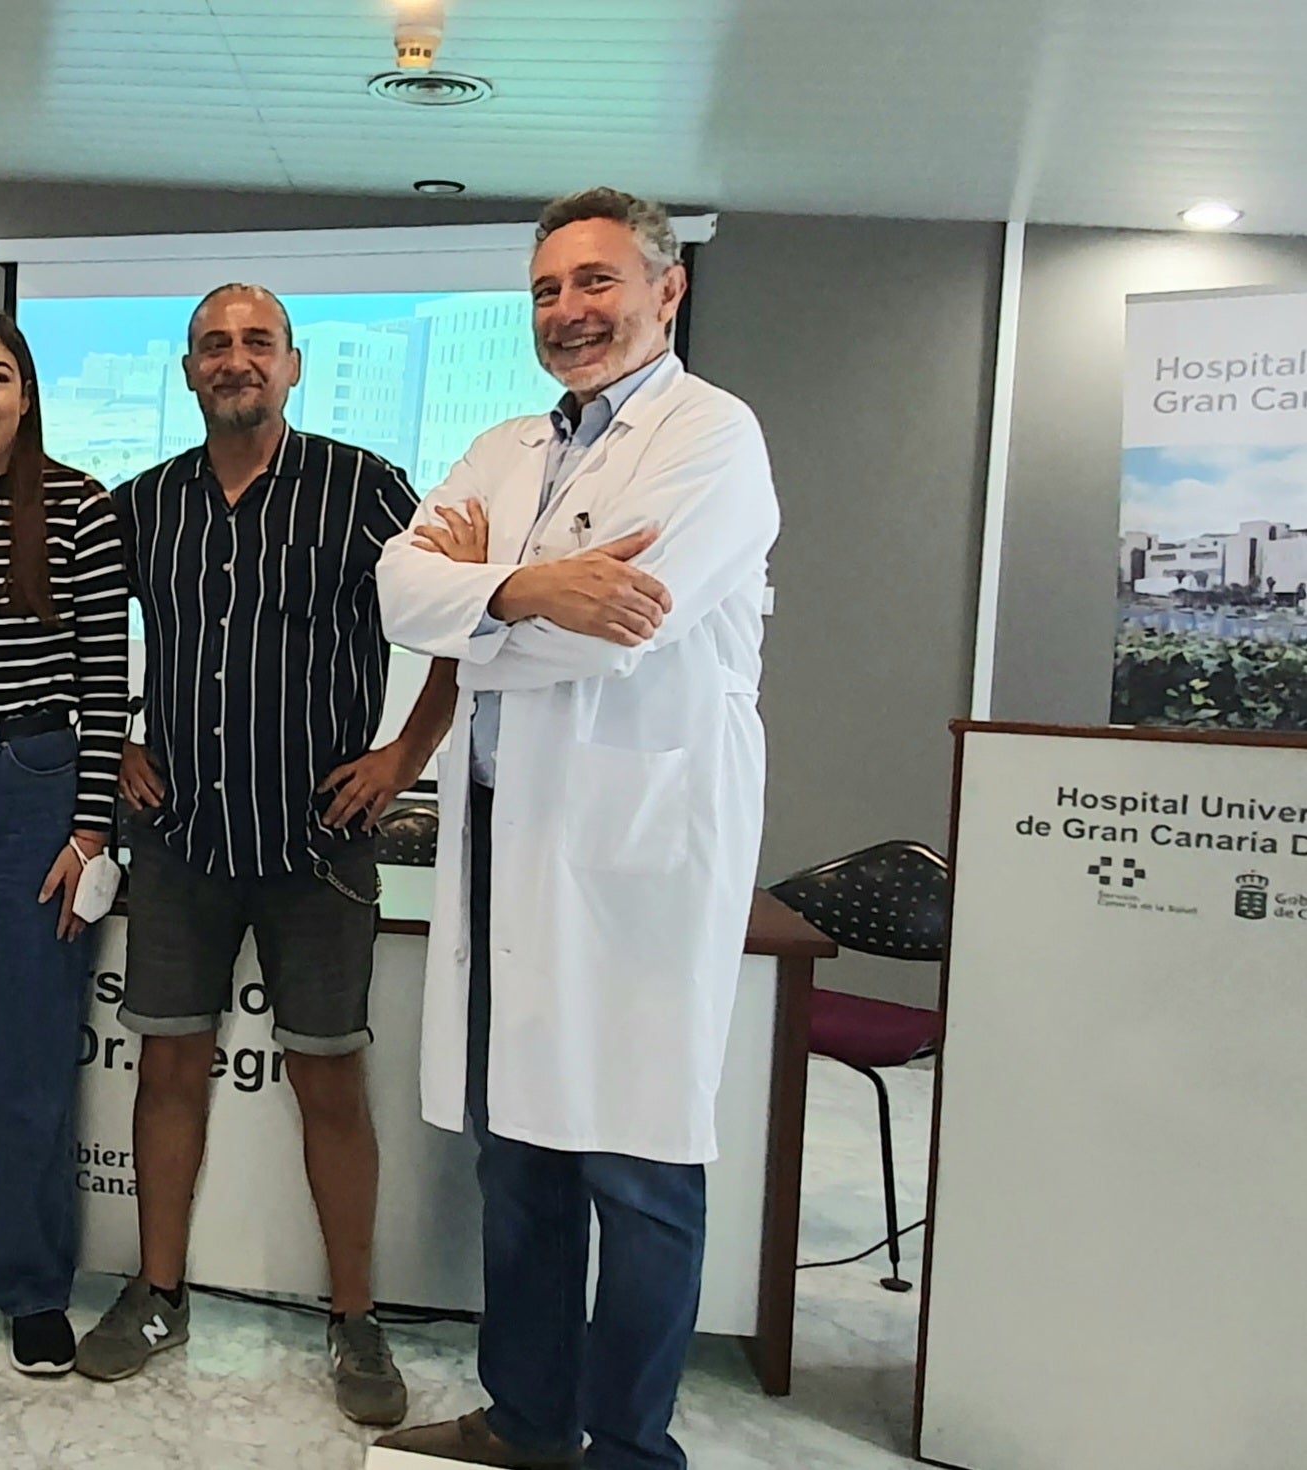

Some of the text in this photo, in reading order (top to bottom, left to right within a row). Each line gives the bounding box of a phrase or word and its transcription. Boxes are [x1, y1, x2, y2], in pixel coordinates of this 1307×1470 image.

[1156, 349, 1307, 382] Hospital
[1153, 390, 1237, 414] Gran
[1057, 786, 1189, 816] Hospital
[1016, 815, 1051, 836] de
[1063, 818, 1138, 843] Gran
[1150, 824, 1278, 854] Canaria
